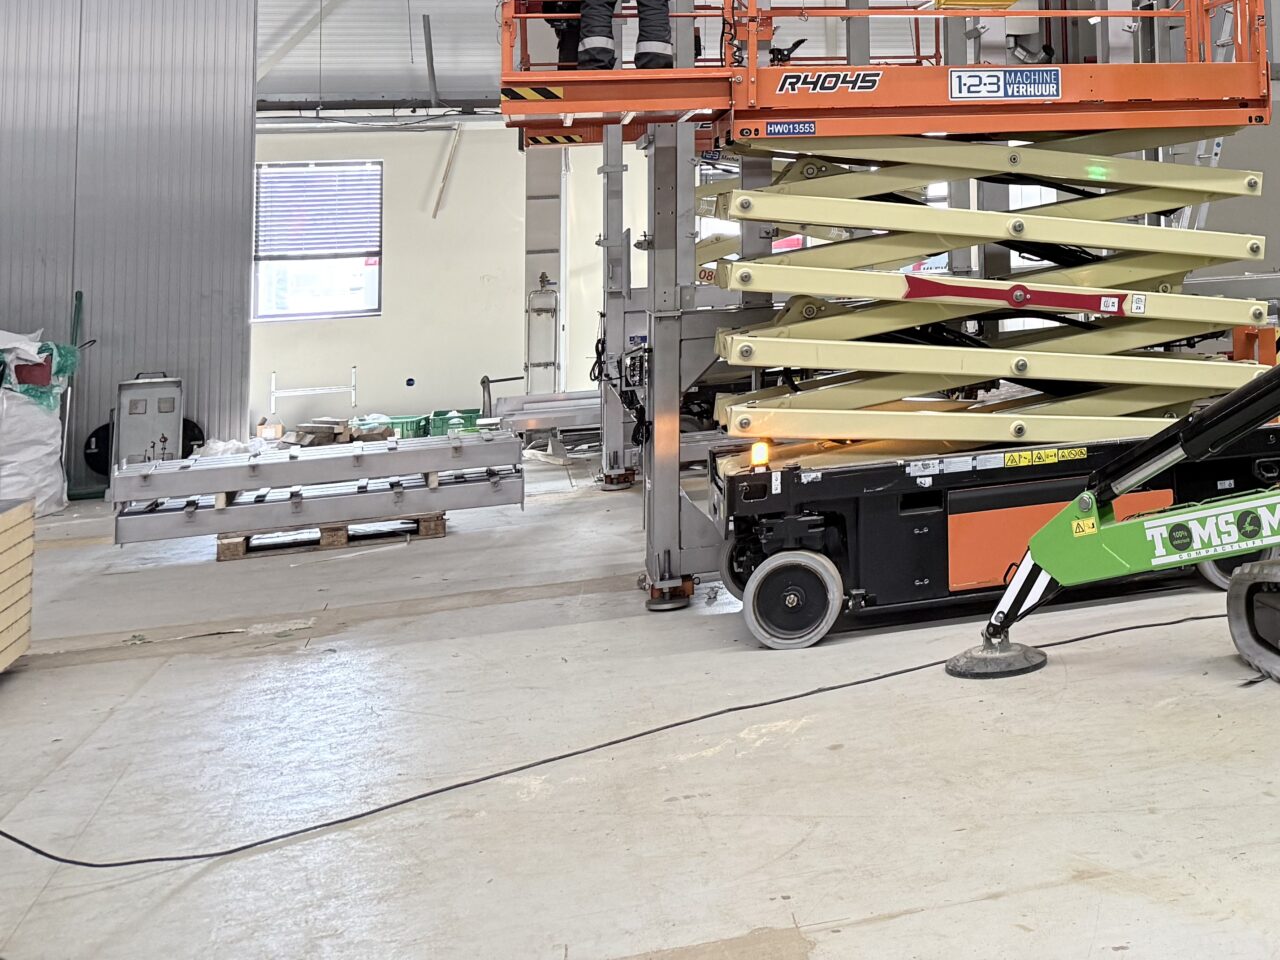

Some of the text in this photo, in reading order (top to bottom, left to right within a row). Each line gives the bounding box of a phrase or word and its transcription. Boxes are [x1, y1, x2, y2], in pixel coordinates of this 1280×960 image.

[776, 71, 883, 94] R4045
[1006, 71, 1057, 84] MACHINE
[1007, 83, 1057, 96] VERHUUR
[767, 123, 815, 133] HW013553
[699, 269, 716, 281] 08
[1178, 540, 1265, 560] COMPACTLIFT
